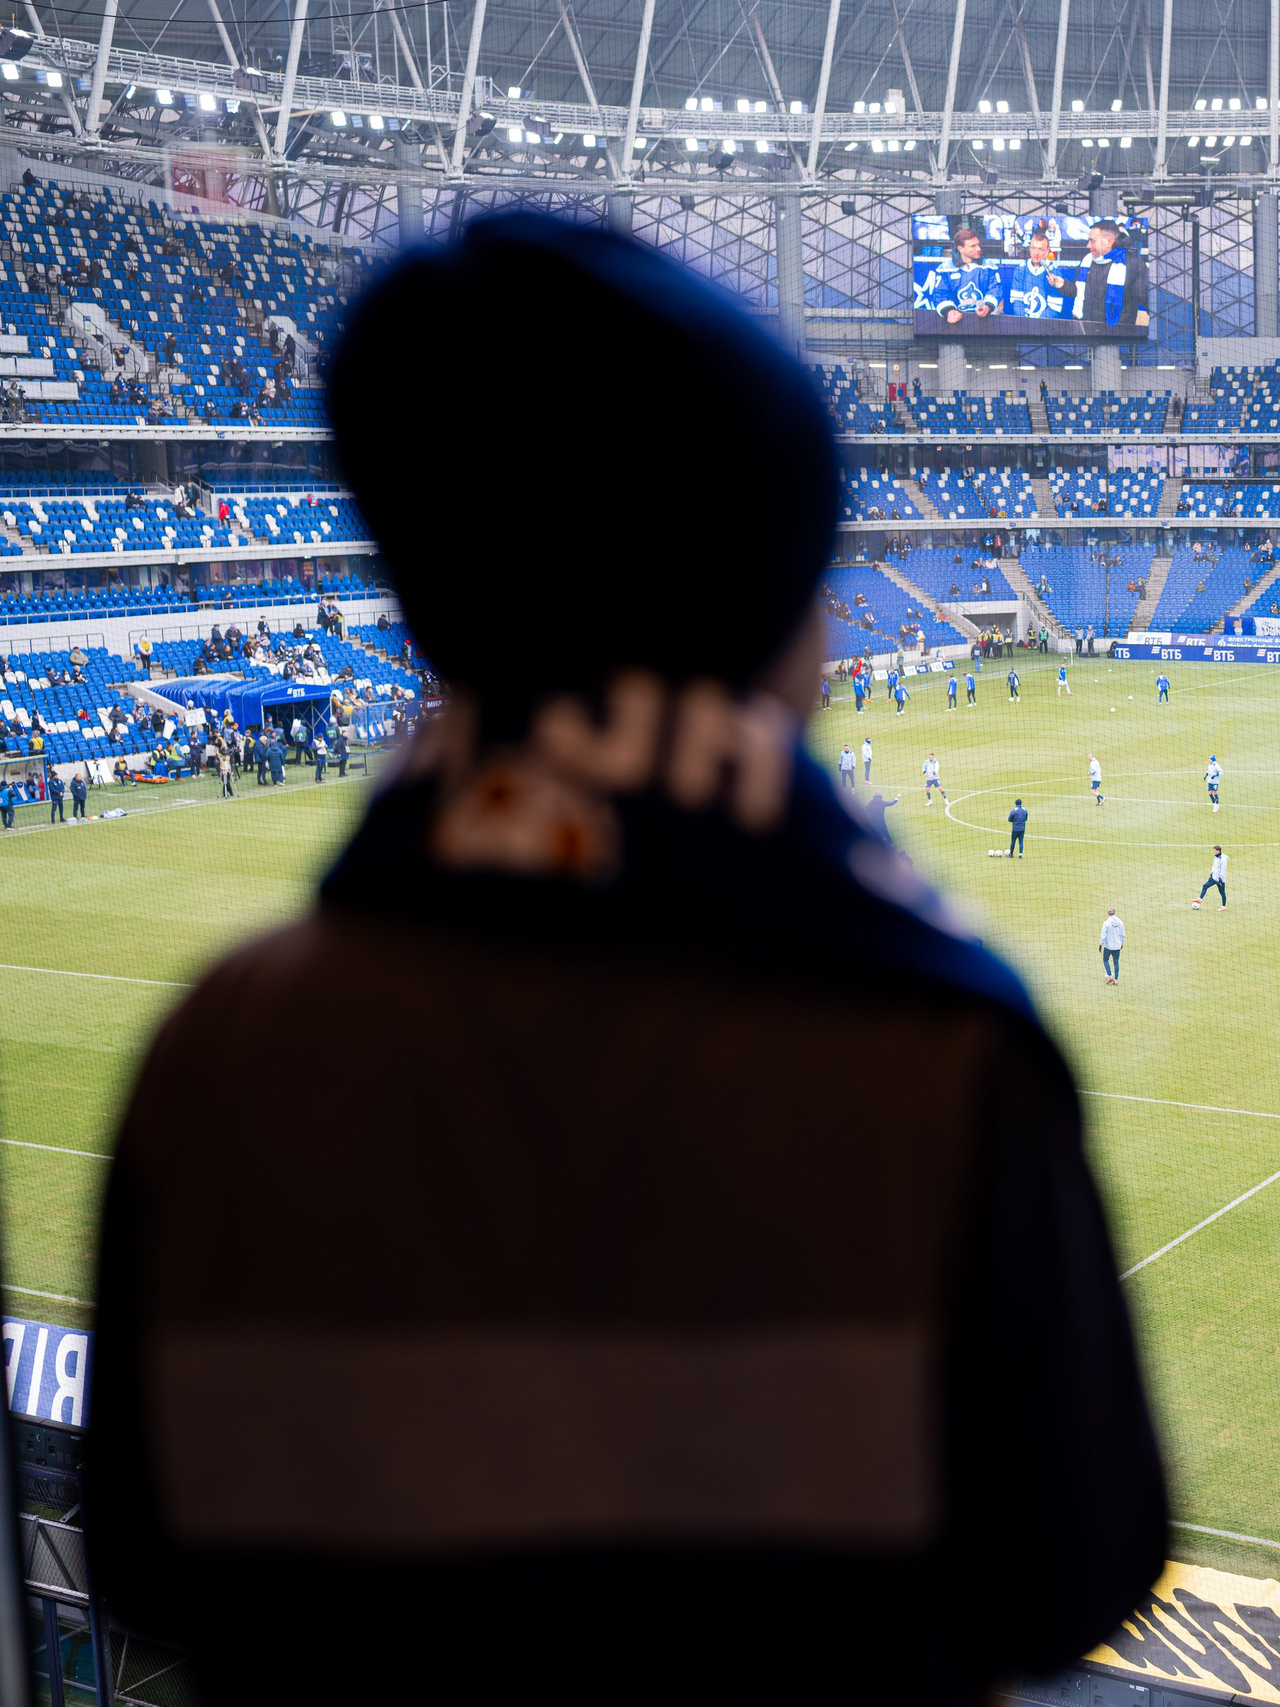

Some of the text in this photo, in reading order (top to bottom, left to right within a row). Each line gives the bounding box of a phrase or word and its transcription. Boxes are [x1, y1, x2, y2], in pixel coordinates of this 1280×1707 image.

[1144, 637, 1162, 645] ВТБ
[1186, 638, 1205, 646] ВТБ
[1161, 649, 1182, 660] ВТБ
[1213, 650, 1235, 662] ВТБ
[293, 687, 306, 698] ВТБ
